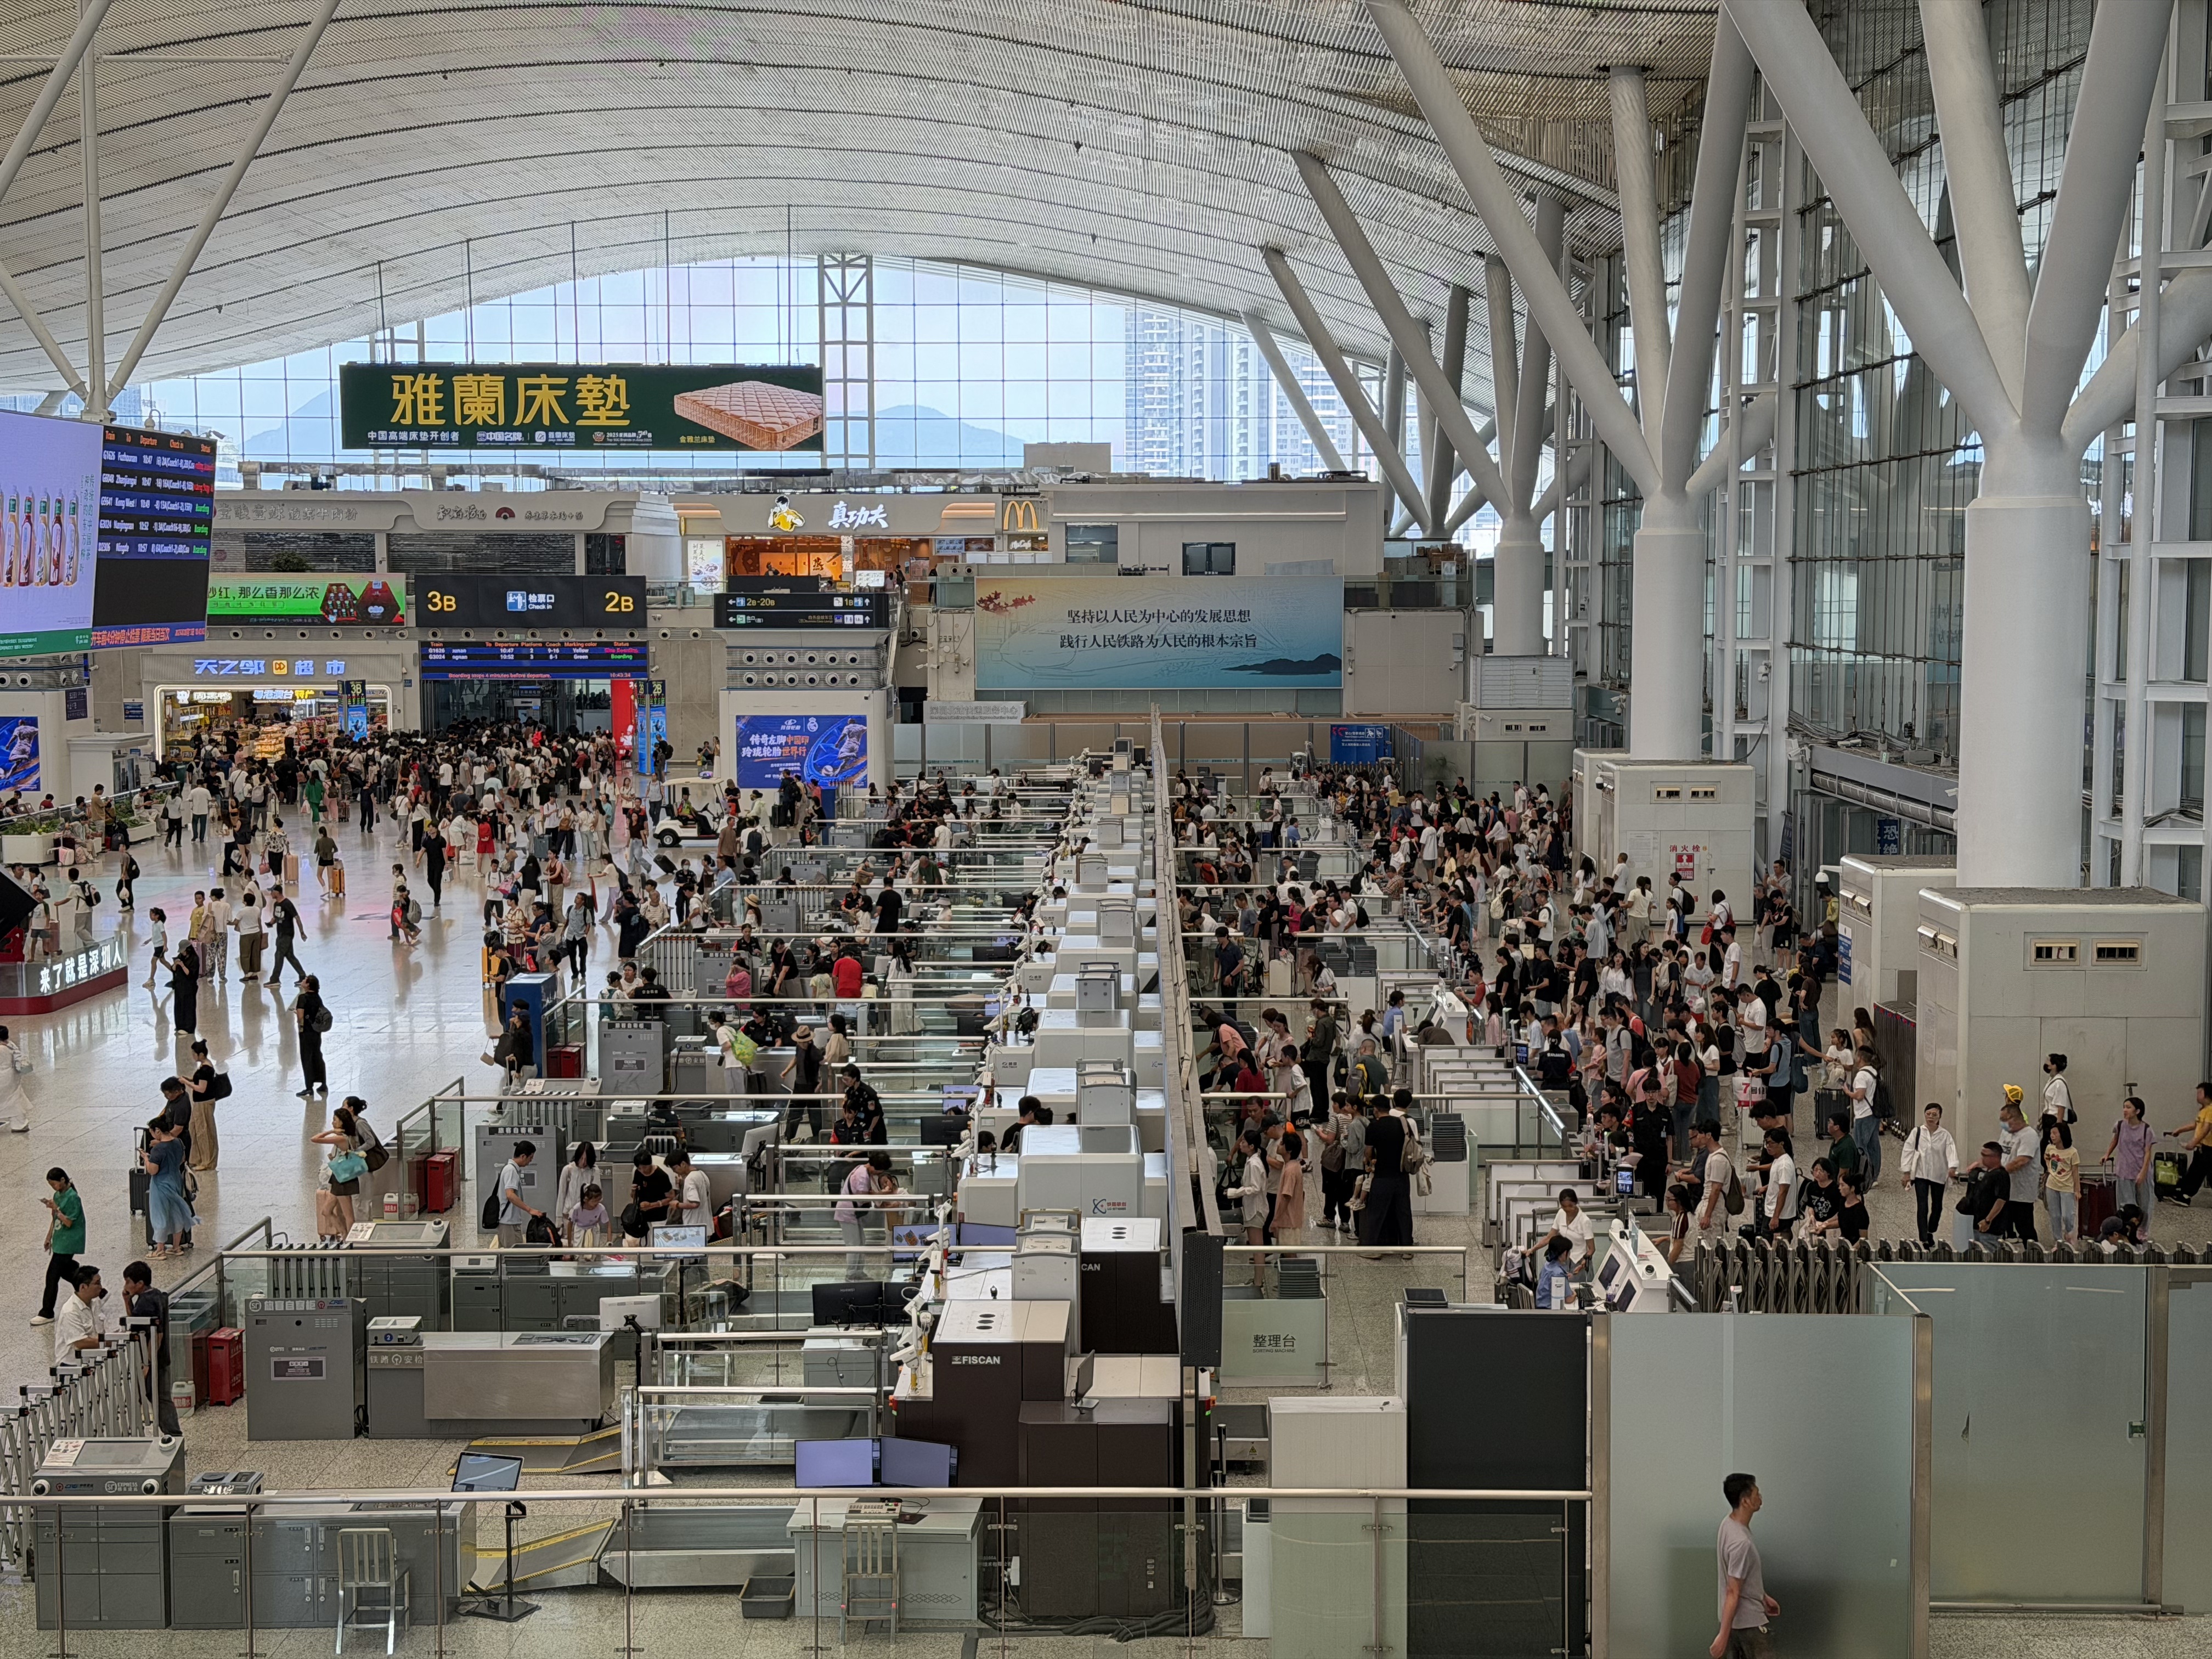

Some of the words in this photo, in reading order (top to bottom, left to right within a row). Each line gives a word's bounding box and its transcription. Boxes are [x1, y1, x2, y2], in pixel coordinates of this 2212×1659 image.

[391, 373, 630, 426] 雅蘭床墊
[368, 431, 459, 441] 中国高端床垫开创者
[828, 501, 888, 529] 真功夫
[427, 591, 456, 612] 3B
[528, 594, 555, 602] 检票口
[605, 591, 634, 612] 2B
[747, 598, 775, 606] 2B-20B
[1068, 609, 1251, 623] 坚持以人民为中心的发展思想
[1060, 634, 1257, 648] 践行人民铁路为人民的根本宗旨
[194, 659, 265, 675] 天之邻
[295, 660, 345, 675] 超市
[351, 684, 362, 694] 3B
[653, 684, 662, 694] 2B
[749, 734, 809, 746] 传奇左脚中国印
[742, 747, 807, 758] 玲珑轮胎世界行
[40, 940, 122, 993] 来了就是深圳人
[1253, 1334, 1296, 1347] 整理台
[962, 1356, 1000, 1364] FISCAN
